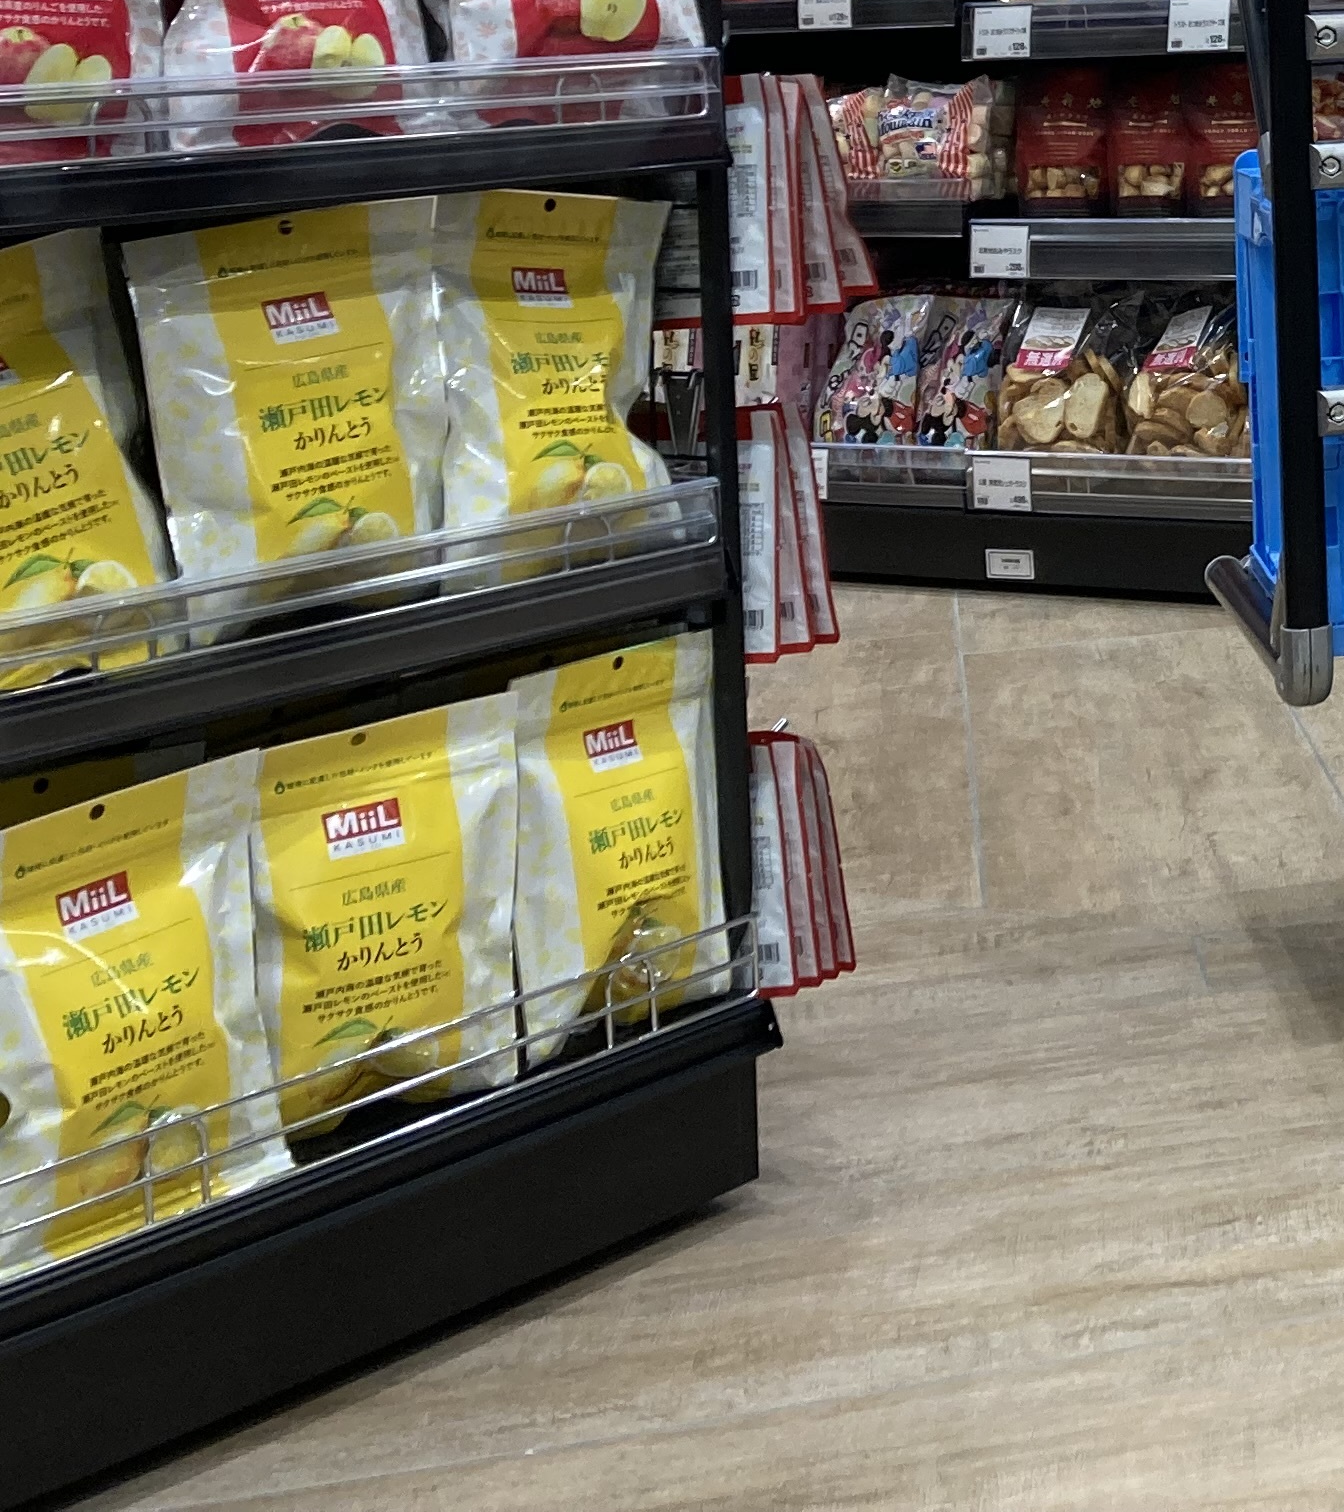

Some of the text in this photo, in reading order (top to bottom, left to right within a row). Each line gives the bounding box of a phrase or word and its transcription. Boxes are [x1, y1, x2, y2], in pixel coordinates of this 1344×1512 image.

[514, 270, 565, 292] MiiL
[265, 293, 330, 328] MiiL
[275, 321, 337, 339] KASUMI
[291, 364, 349, 388] 広島県産
[511, 351, 611, 376] 瀬戸田レモ
[259, 388, 389, 434] 瀬戸田レモン
[293, 417, 372, 451] かりんとう
[585, 725, 633, 755] MiiL
[325, 803, 398, 840] MiiL
[588, 809, 684, 856] 瀬戸田レモン
[332, 832, 400, 852] KASUMI
[618, 836, 675, 871] かりんとう
[59, 879, 128, 921] MiiL
[342, 877, 406, 907] 広島県産
[68, 905, 133, 934] KASUMI
[304, 899, 448, 954] 瀬戸田レモン
[336, 932, 423, 971] かりんとう
[63, 968, 200, 1040] 瀬戸田レモン
[102, 1004, 184, 1055] かりんとう
